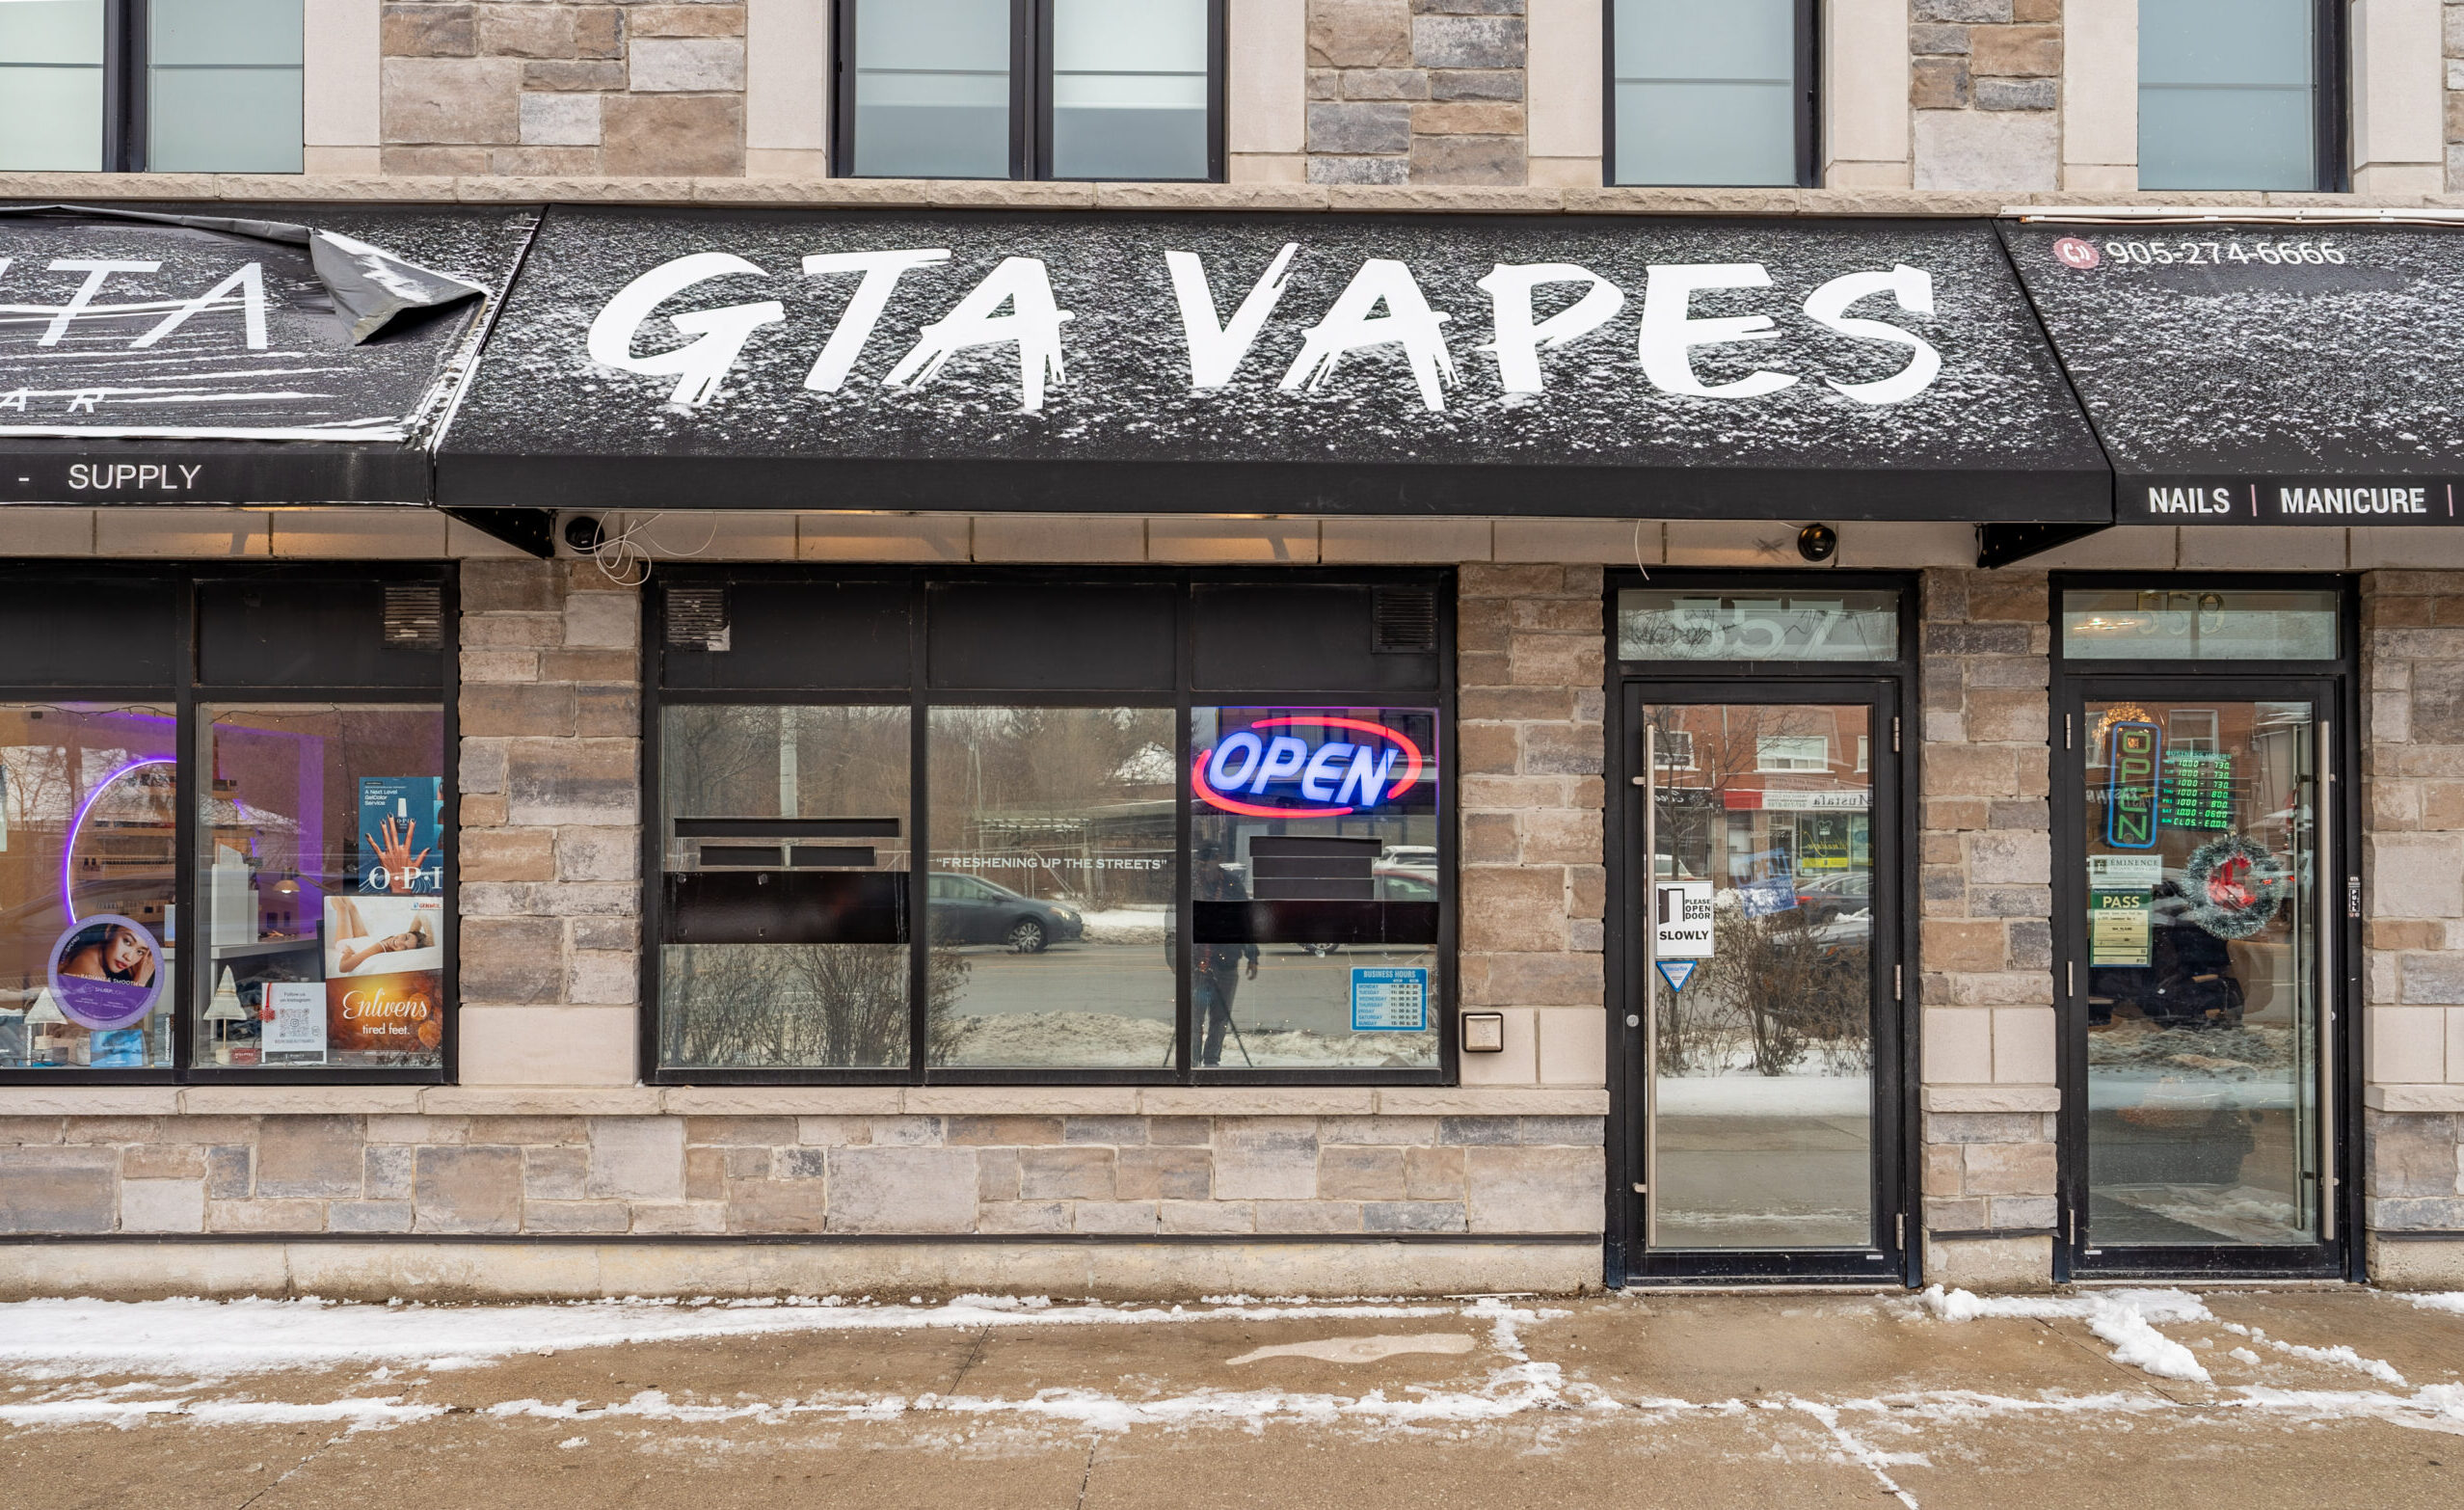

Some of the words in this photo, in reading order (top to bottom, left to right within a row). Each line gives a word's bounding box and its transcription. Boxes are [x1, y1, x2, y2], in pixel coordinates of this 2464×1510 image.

[2105, 241, 2345, 265] 905-274-6666
[587, 249, 1076, 409] GTA
[1165, 242, 1942, 412] VAPES
[68, 464, 201, 490] SUPPLY
[2148, 487, 2230, 514] NAILS
[2280, 488, 2426, 514] MANICURE
[1209, 731, 1399, 808] OPEN
[2118, 731, 2151, 841] OPEN
[1041, 858, 1061, 869] UP
[1064, 858, 1092, 869] THE
[2102, 896, 2140, 908] PASS
[1659, 930, 1709, 940] SLOWLY
[342, 987, 427, 1019] Enlivens
[362, 1023, 386, 1035] tired
[388, 1022, 411, 1035] feet.
